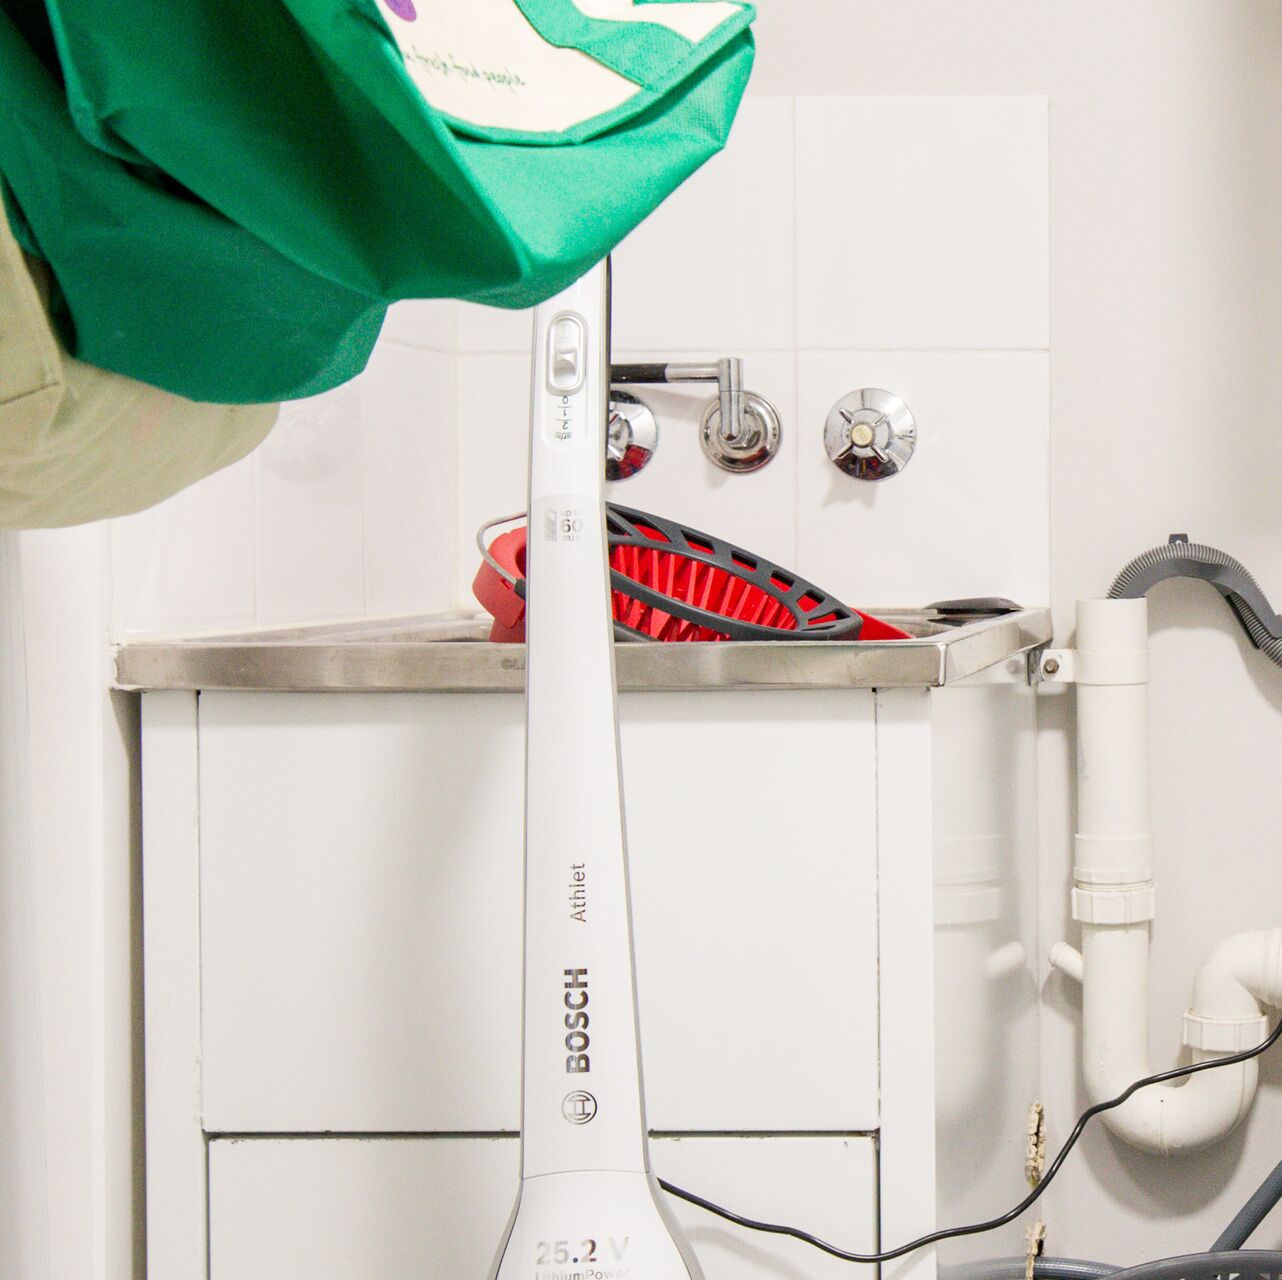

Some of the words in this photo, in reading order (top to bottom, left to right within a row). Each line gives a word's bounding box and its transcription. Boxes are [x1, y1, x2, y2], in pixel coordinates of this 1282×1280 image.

[561, 519, 583, 533] 60
[569, 862, 586, 923] Athlet
[564, 968, 591, 1074] BOSCH
[536, 1239, 597, 1265] 25.2
[608, 1236, 630, 1260] V
